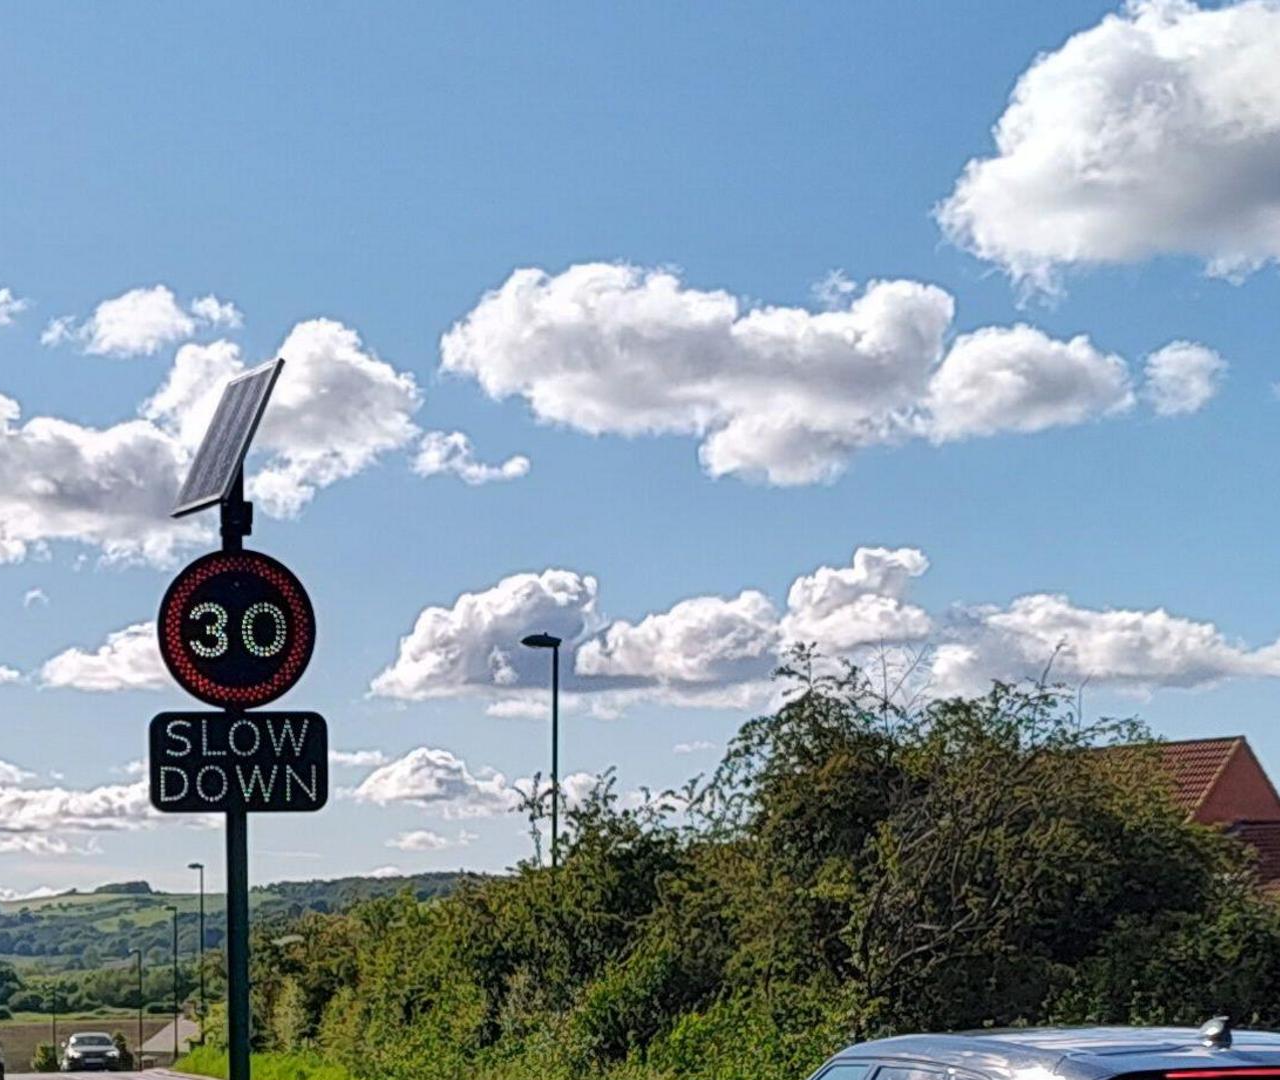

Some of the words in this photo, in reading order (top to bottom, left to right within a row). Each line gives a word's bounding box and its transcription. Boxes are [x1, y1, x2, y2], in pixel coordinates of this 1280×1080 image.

[189, 602, 287, 658] 30
[166, 719, 309, 757] SLOW
[160, 764, 317, 803] DOWN
